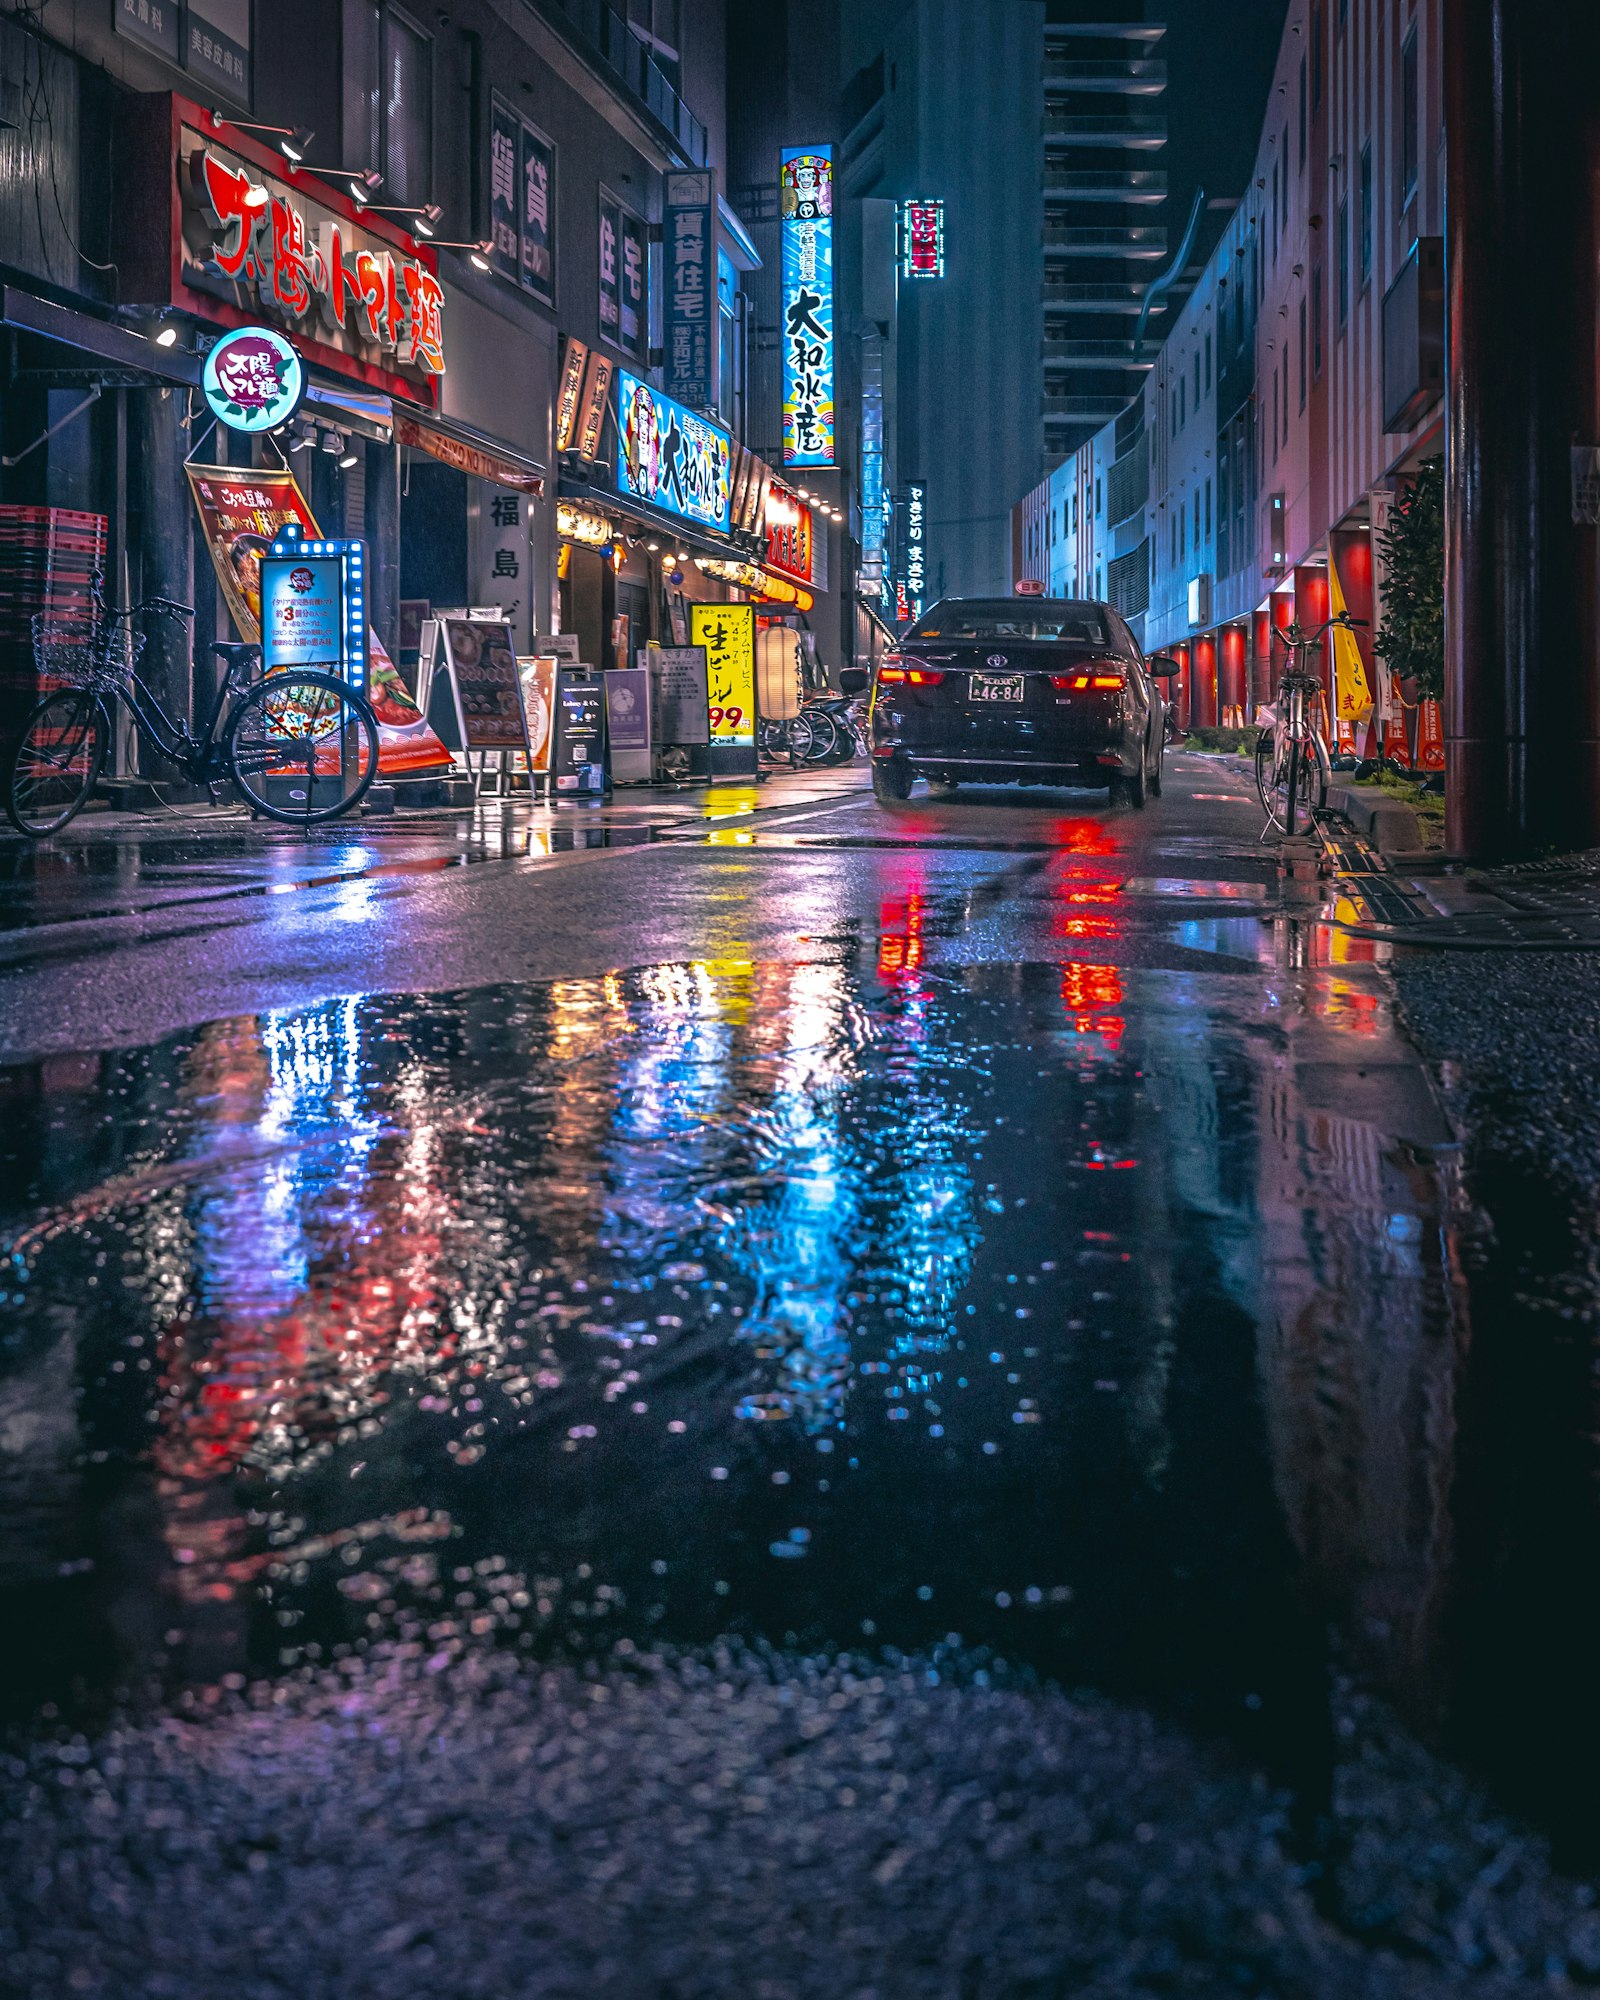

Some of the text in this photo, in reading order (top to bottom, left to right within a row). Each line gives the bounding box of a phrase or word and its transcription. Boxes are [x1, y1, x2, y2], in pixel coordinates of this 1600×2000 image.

[192, 26, 244, 82] 美容皮膚科
[673, 211, 704, 319] 賃貸住宅
[786, 286, 830, 452] 大和水産
[466, 449, 479, 472] NO
[662, 406, 724, 521] 大和水産
[702, 621, 732, 703] 生ビール
[982, 686, 1020, 700] 46-84
